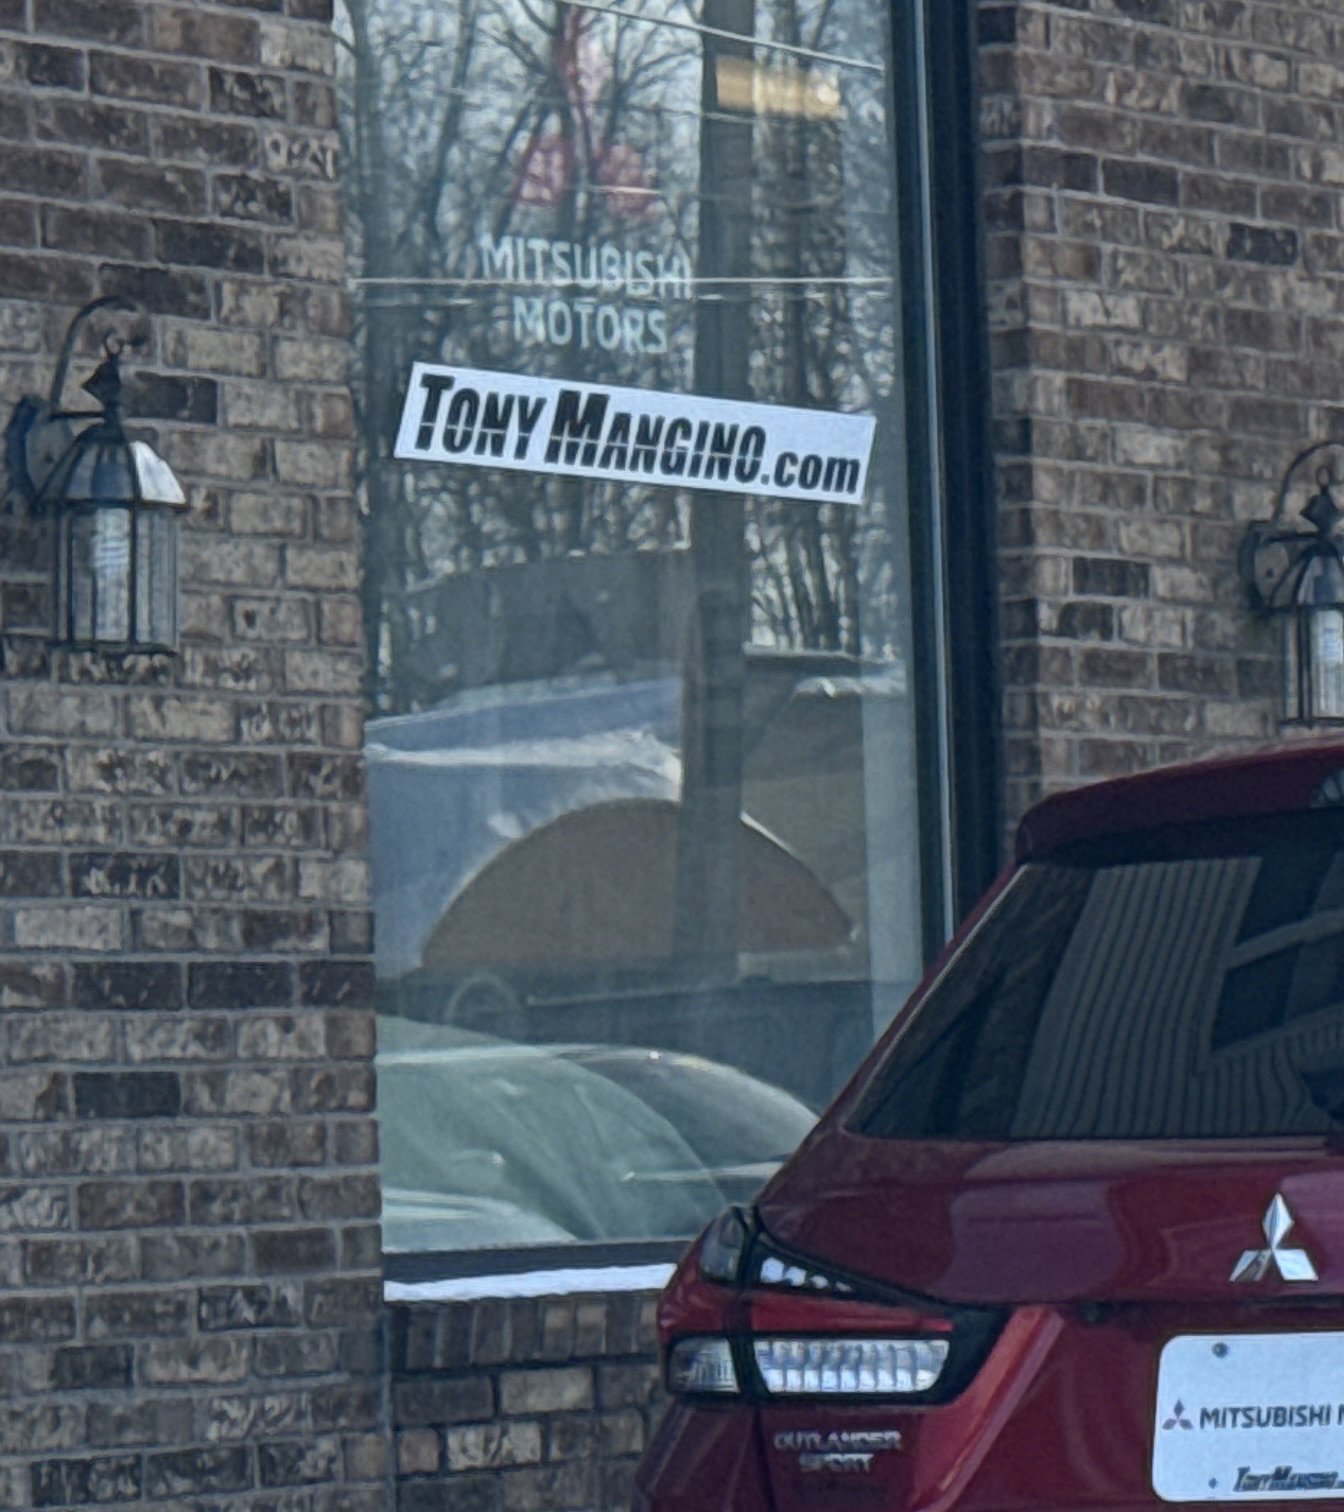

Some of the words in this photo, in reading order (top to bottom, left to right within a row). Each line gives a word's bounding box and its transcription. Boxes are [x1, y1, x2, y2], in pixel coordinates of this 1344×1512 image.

[479, 234, 693, 299] MITSUBISHI
[513, 298, 668, 355] MOTORS
[1200, 1404, 1331, 1430] MITSUBISHI
[773, 1429, 903, 1451] OUTLANDER
